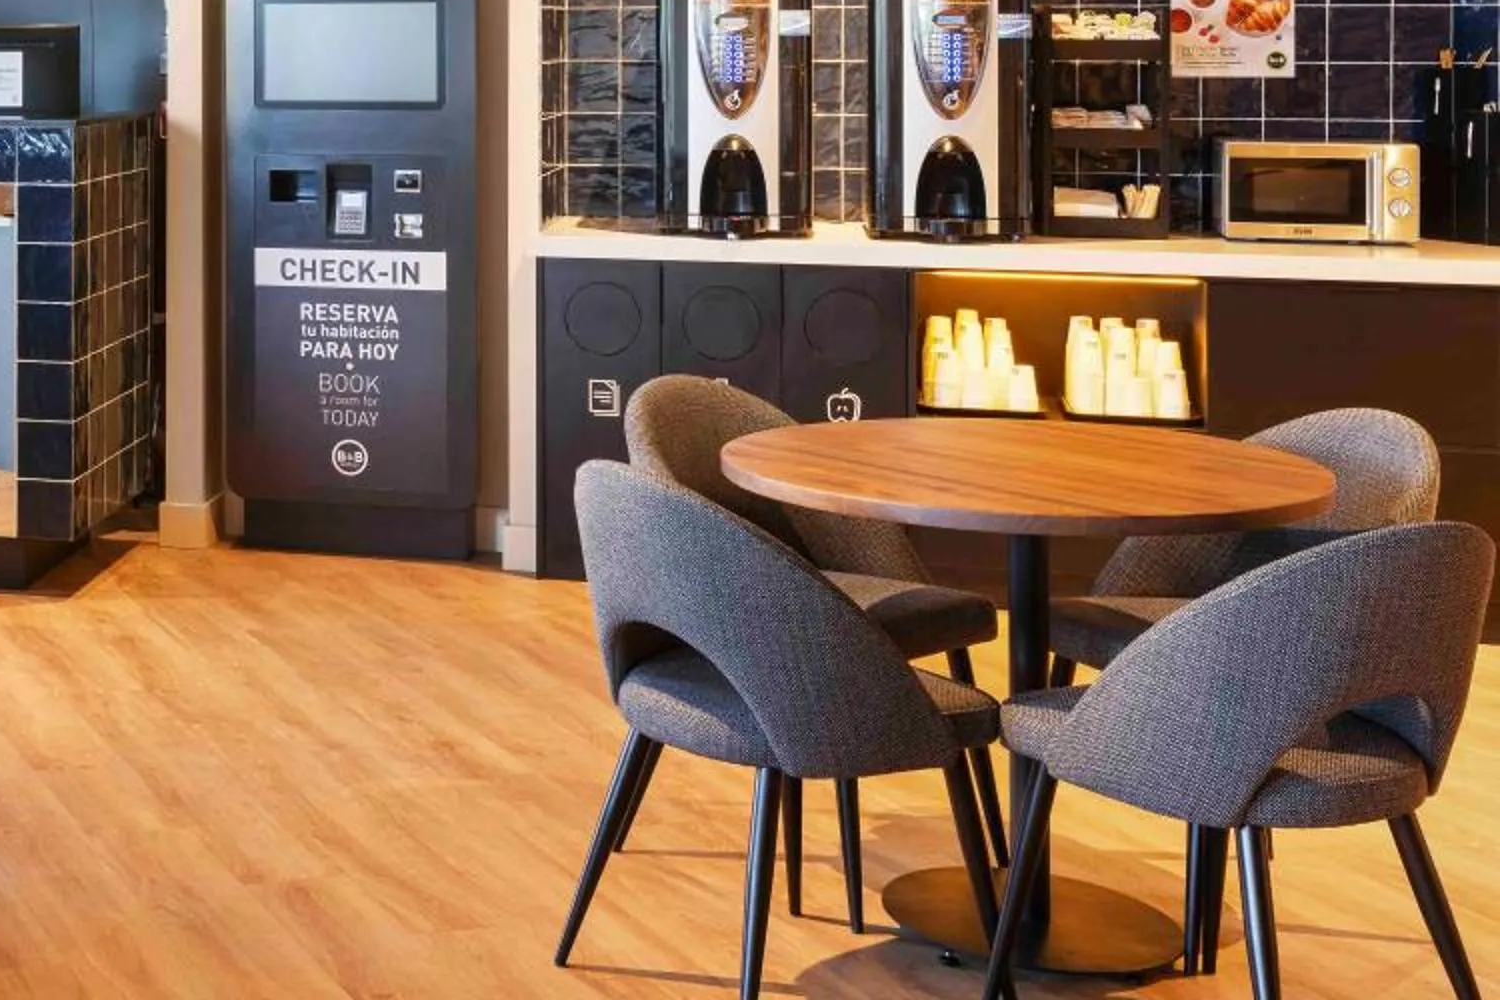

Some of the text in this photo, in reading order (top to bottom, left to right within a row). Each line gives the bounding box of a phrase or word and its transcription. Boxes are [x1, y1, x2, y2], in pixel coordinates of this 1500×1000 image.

[280, 258, 420, 285] CHECK-IN
[299, 302, 399, 324] RESERVA
[301, 324, 400, 340] tu habitación
[299, 342, 400, 361] PARA HOY
[318, 371, 381, 394] BOOK
[320, 408, 379, 427] TODAY
